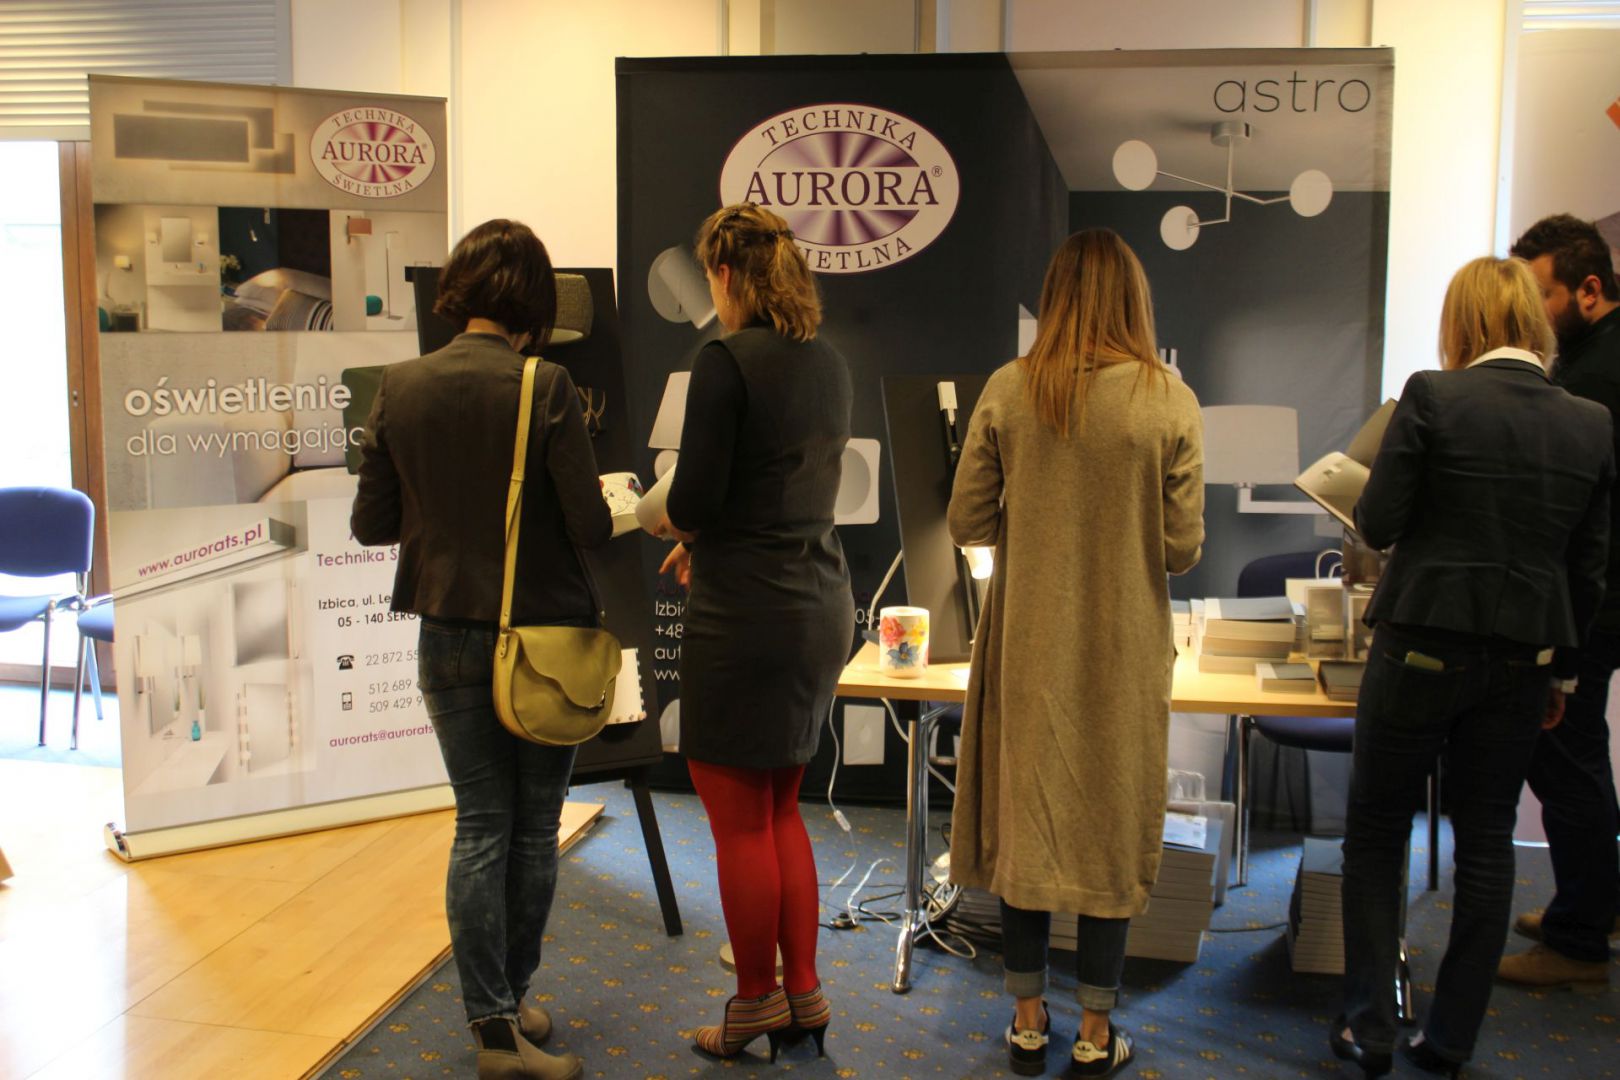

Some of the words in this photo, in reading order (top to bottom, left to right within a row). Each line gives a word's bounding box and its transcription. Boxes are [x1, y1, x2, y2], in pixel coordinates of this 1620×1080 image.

[1214, 71, 1370, 112] astro
[332, 109, 415, 133] TECHNIKA
[762, 110, 917, 150] TECHNIKA
[321, 141, 425, 164] AURORA
[804, 236, 912, 269] IETLNA
[123, 376, 353, 417] oświetlenie
[126, 428, 178, 457] dla
[187, 422, 364, 458] wymagając
[138, 523, 262, 577] www.aurorats.pl
[316, 549, 386, 567] Technika
[318, 597, 359, 610] Izbica,
[362, 594, 376, 606] ul.
[378, 593, 392, 604] Le
[655, 600, 685, 617] Izbi
[337, 615, 352, 628] 05
[364, 612, 384, 624] 140
[387, 610, 418, 622] SERO
[365, 654, 380, 667] 22
[382, 651, 403, 665] 872
[368, 682, 389, 696] 512
[391, 678, 412, 692] 689
[369, 699, 389, 713] 509
[393, 696, 413, 709] 429
[329, 724, 433, 747] aurorats@aurorats
